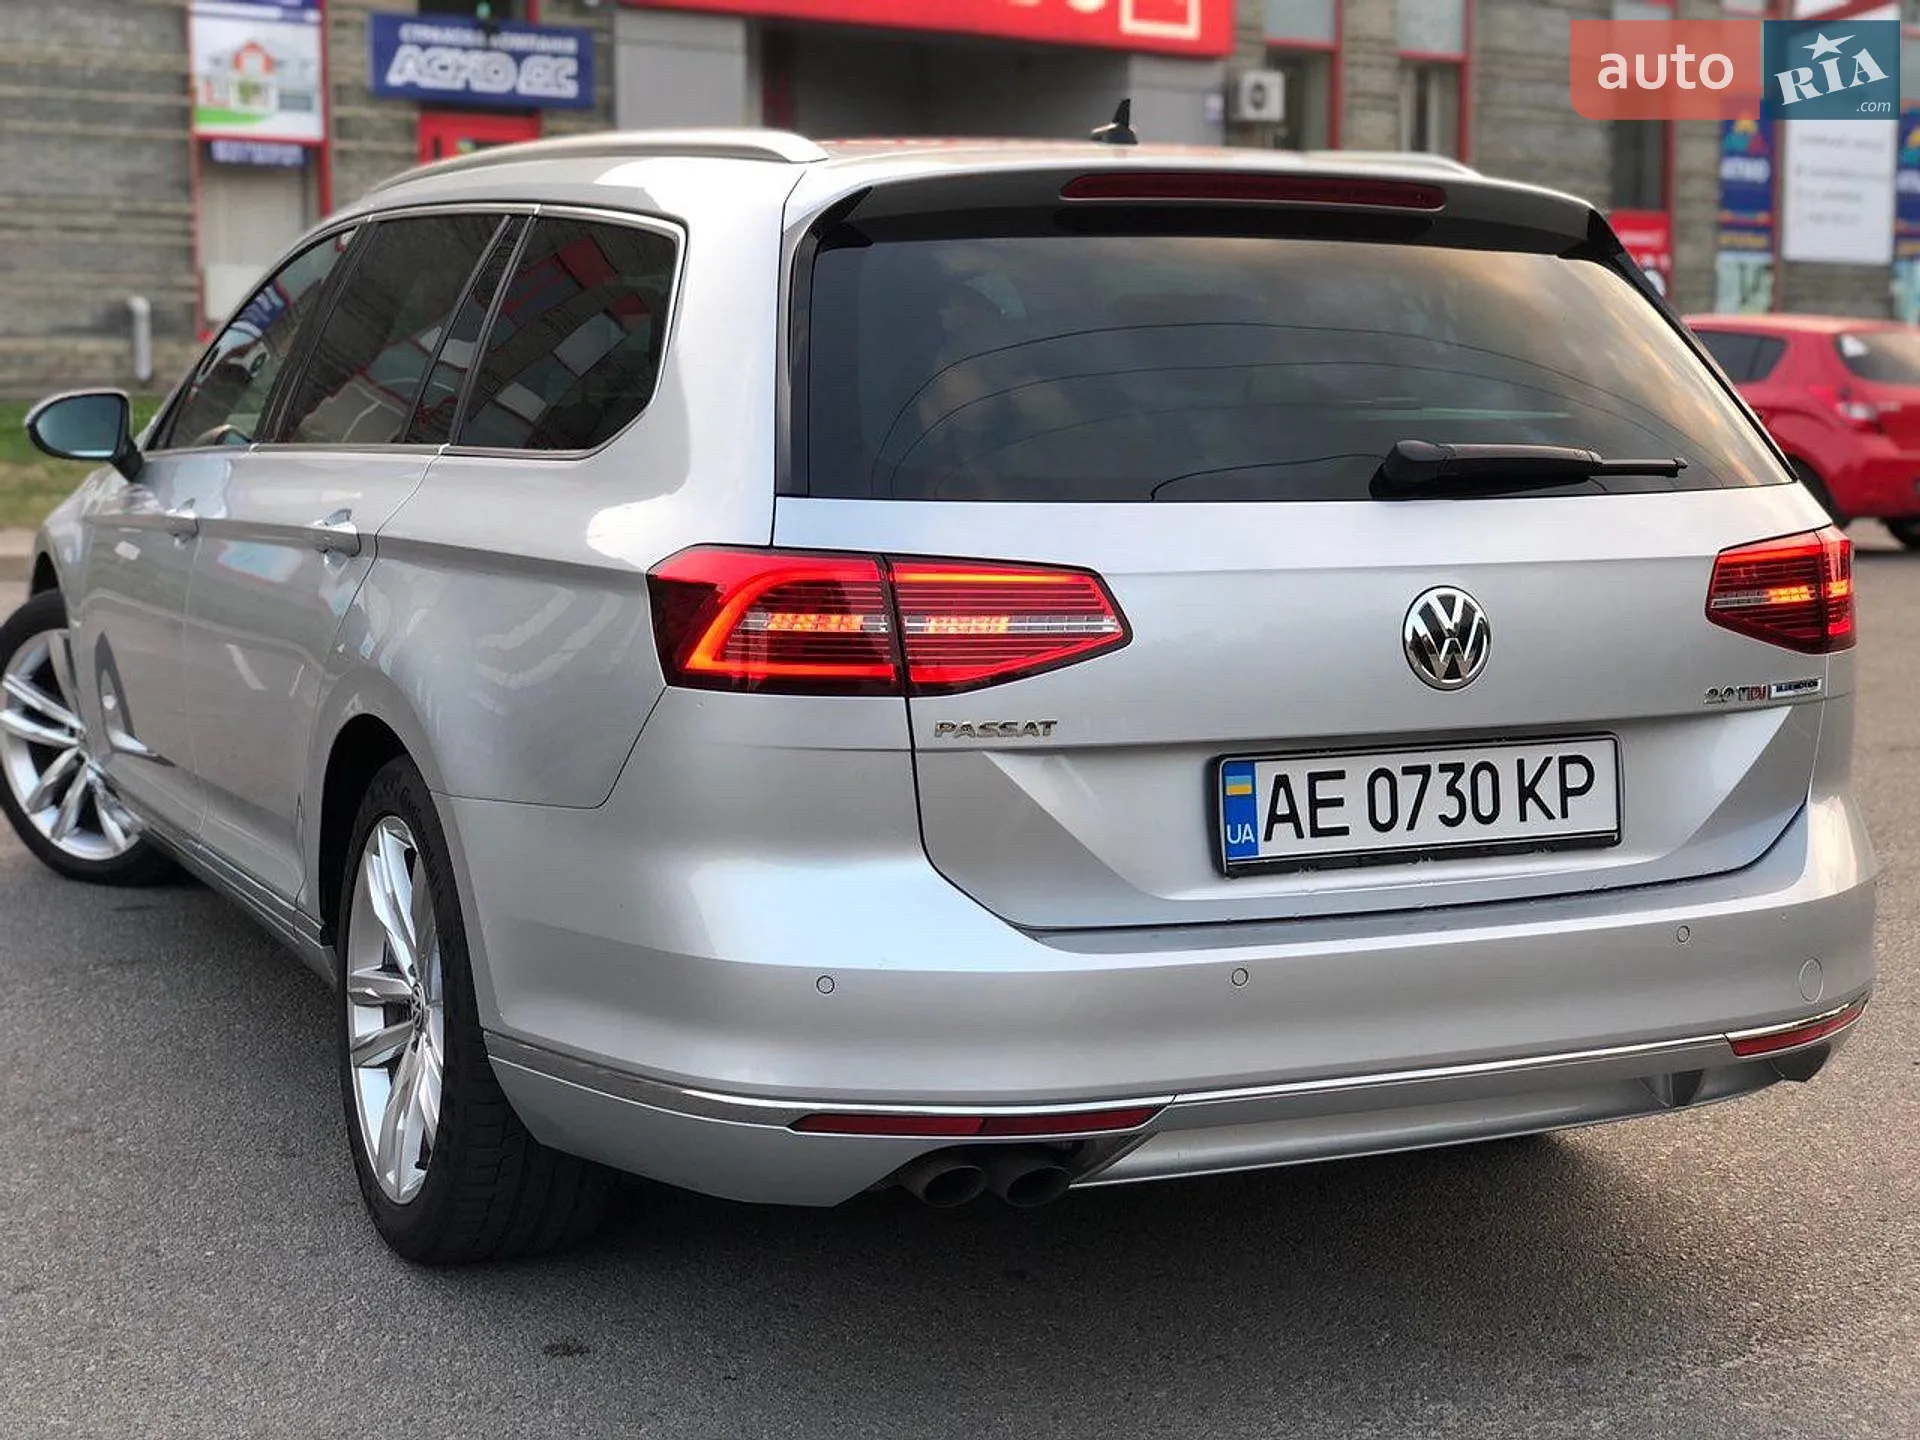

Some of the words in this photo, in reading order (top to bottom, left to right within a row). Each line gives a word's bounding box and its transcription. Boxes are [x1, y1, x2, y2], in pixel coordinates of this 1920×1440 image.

[1703, 685, 1736, 705] 2.0
[1737, 683, 1767, 702] TDI
[935, 719, 1058, 738] PASSAT
[1263, 769, 1350, 842] AE
[1366, 760, 1501, 833] 0730
[1516, 754, 1595, 823] KP
[1226, 823, 1256, 845] UA
